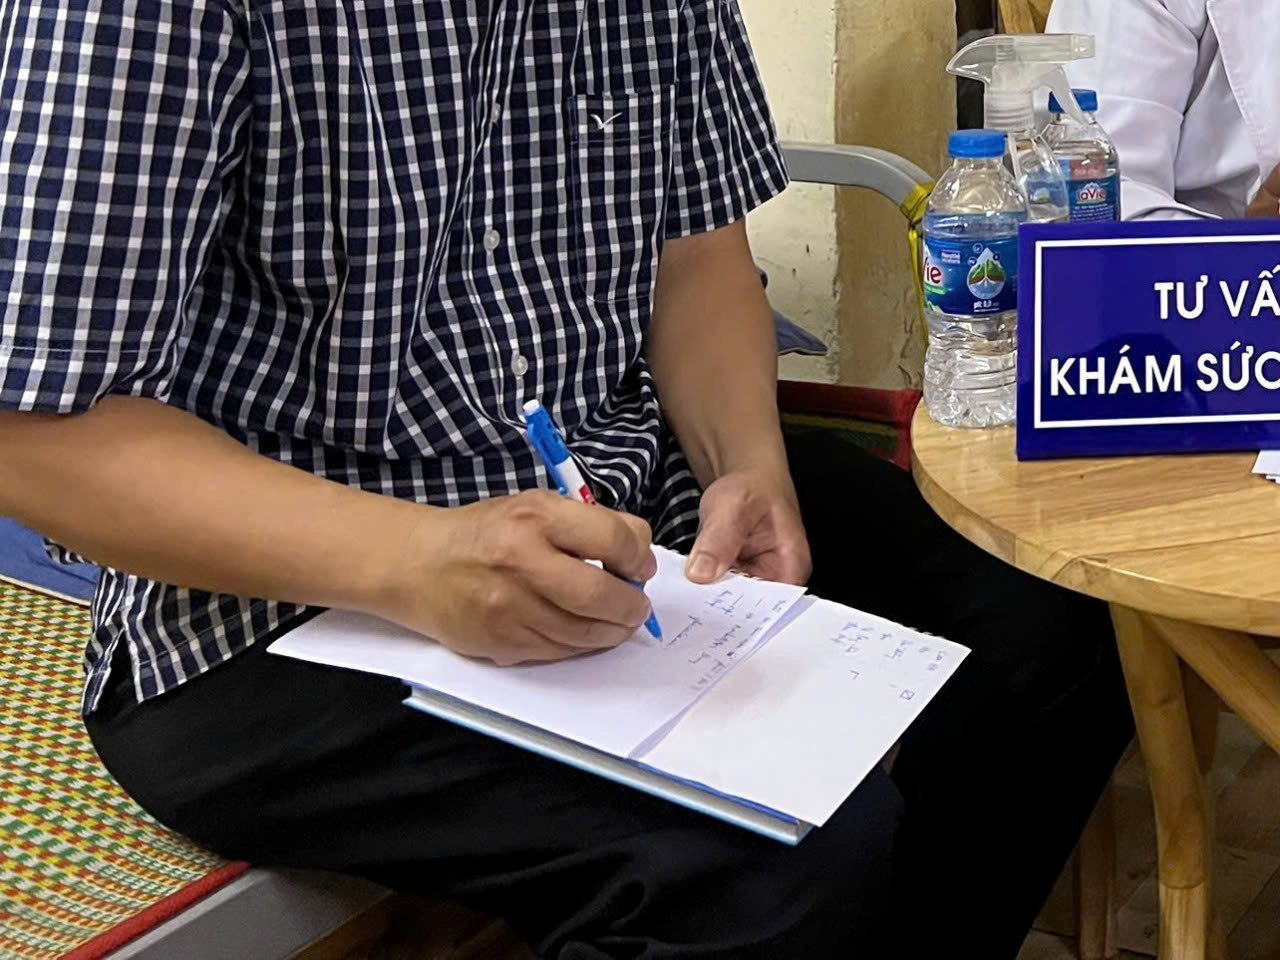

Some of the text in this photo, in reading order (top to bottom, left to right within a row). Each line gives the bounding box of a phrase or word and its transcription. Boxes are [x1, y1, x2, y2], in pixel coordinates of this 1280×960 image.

[1078, 188, 1105, 200] laVie
[1154, 275, 1208, 320] TƯ
[1050, 345, 1182, 396] KHÁM
